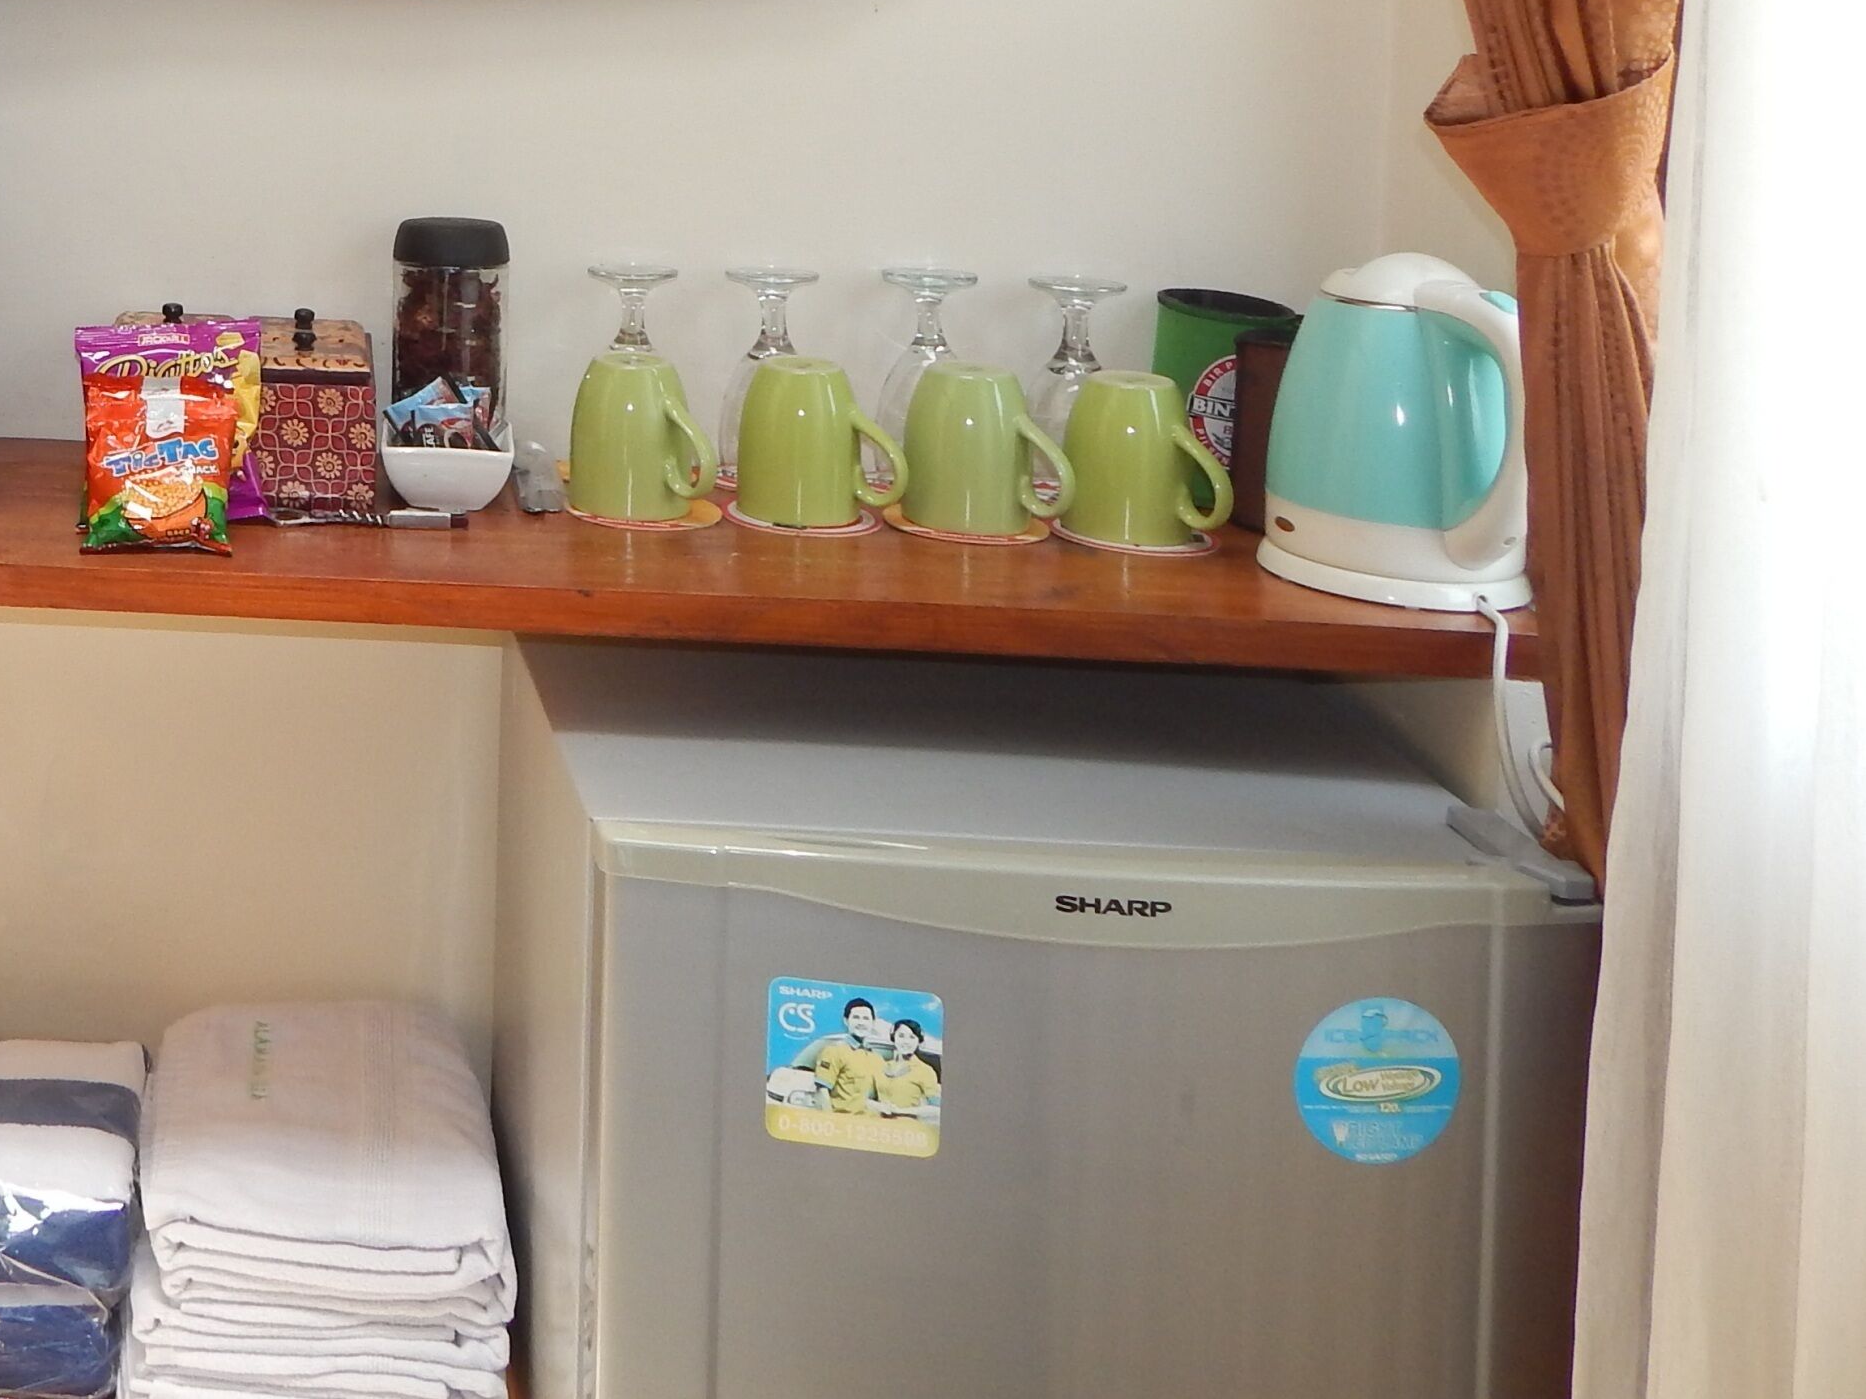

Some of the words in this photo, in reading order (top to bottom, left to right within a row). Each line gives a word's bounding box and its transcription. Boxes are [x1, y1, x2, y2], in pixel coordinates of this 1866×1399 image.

[1203, 366, 1224, 388] BIR
[1055, 895, 1172, 917] SHARP
[779, 985, 833, 1000] SHARP
[778, 1002, 816, 1033] CS
